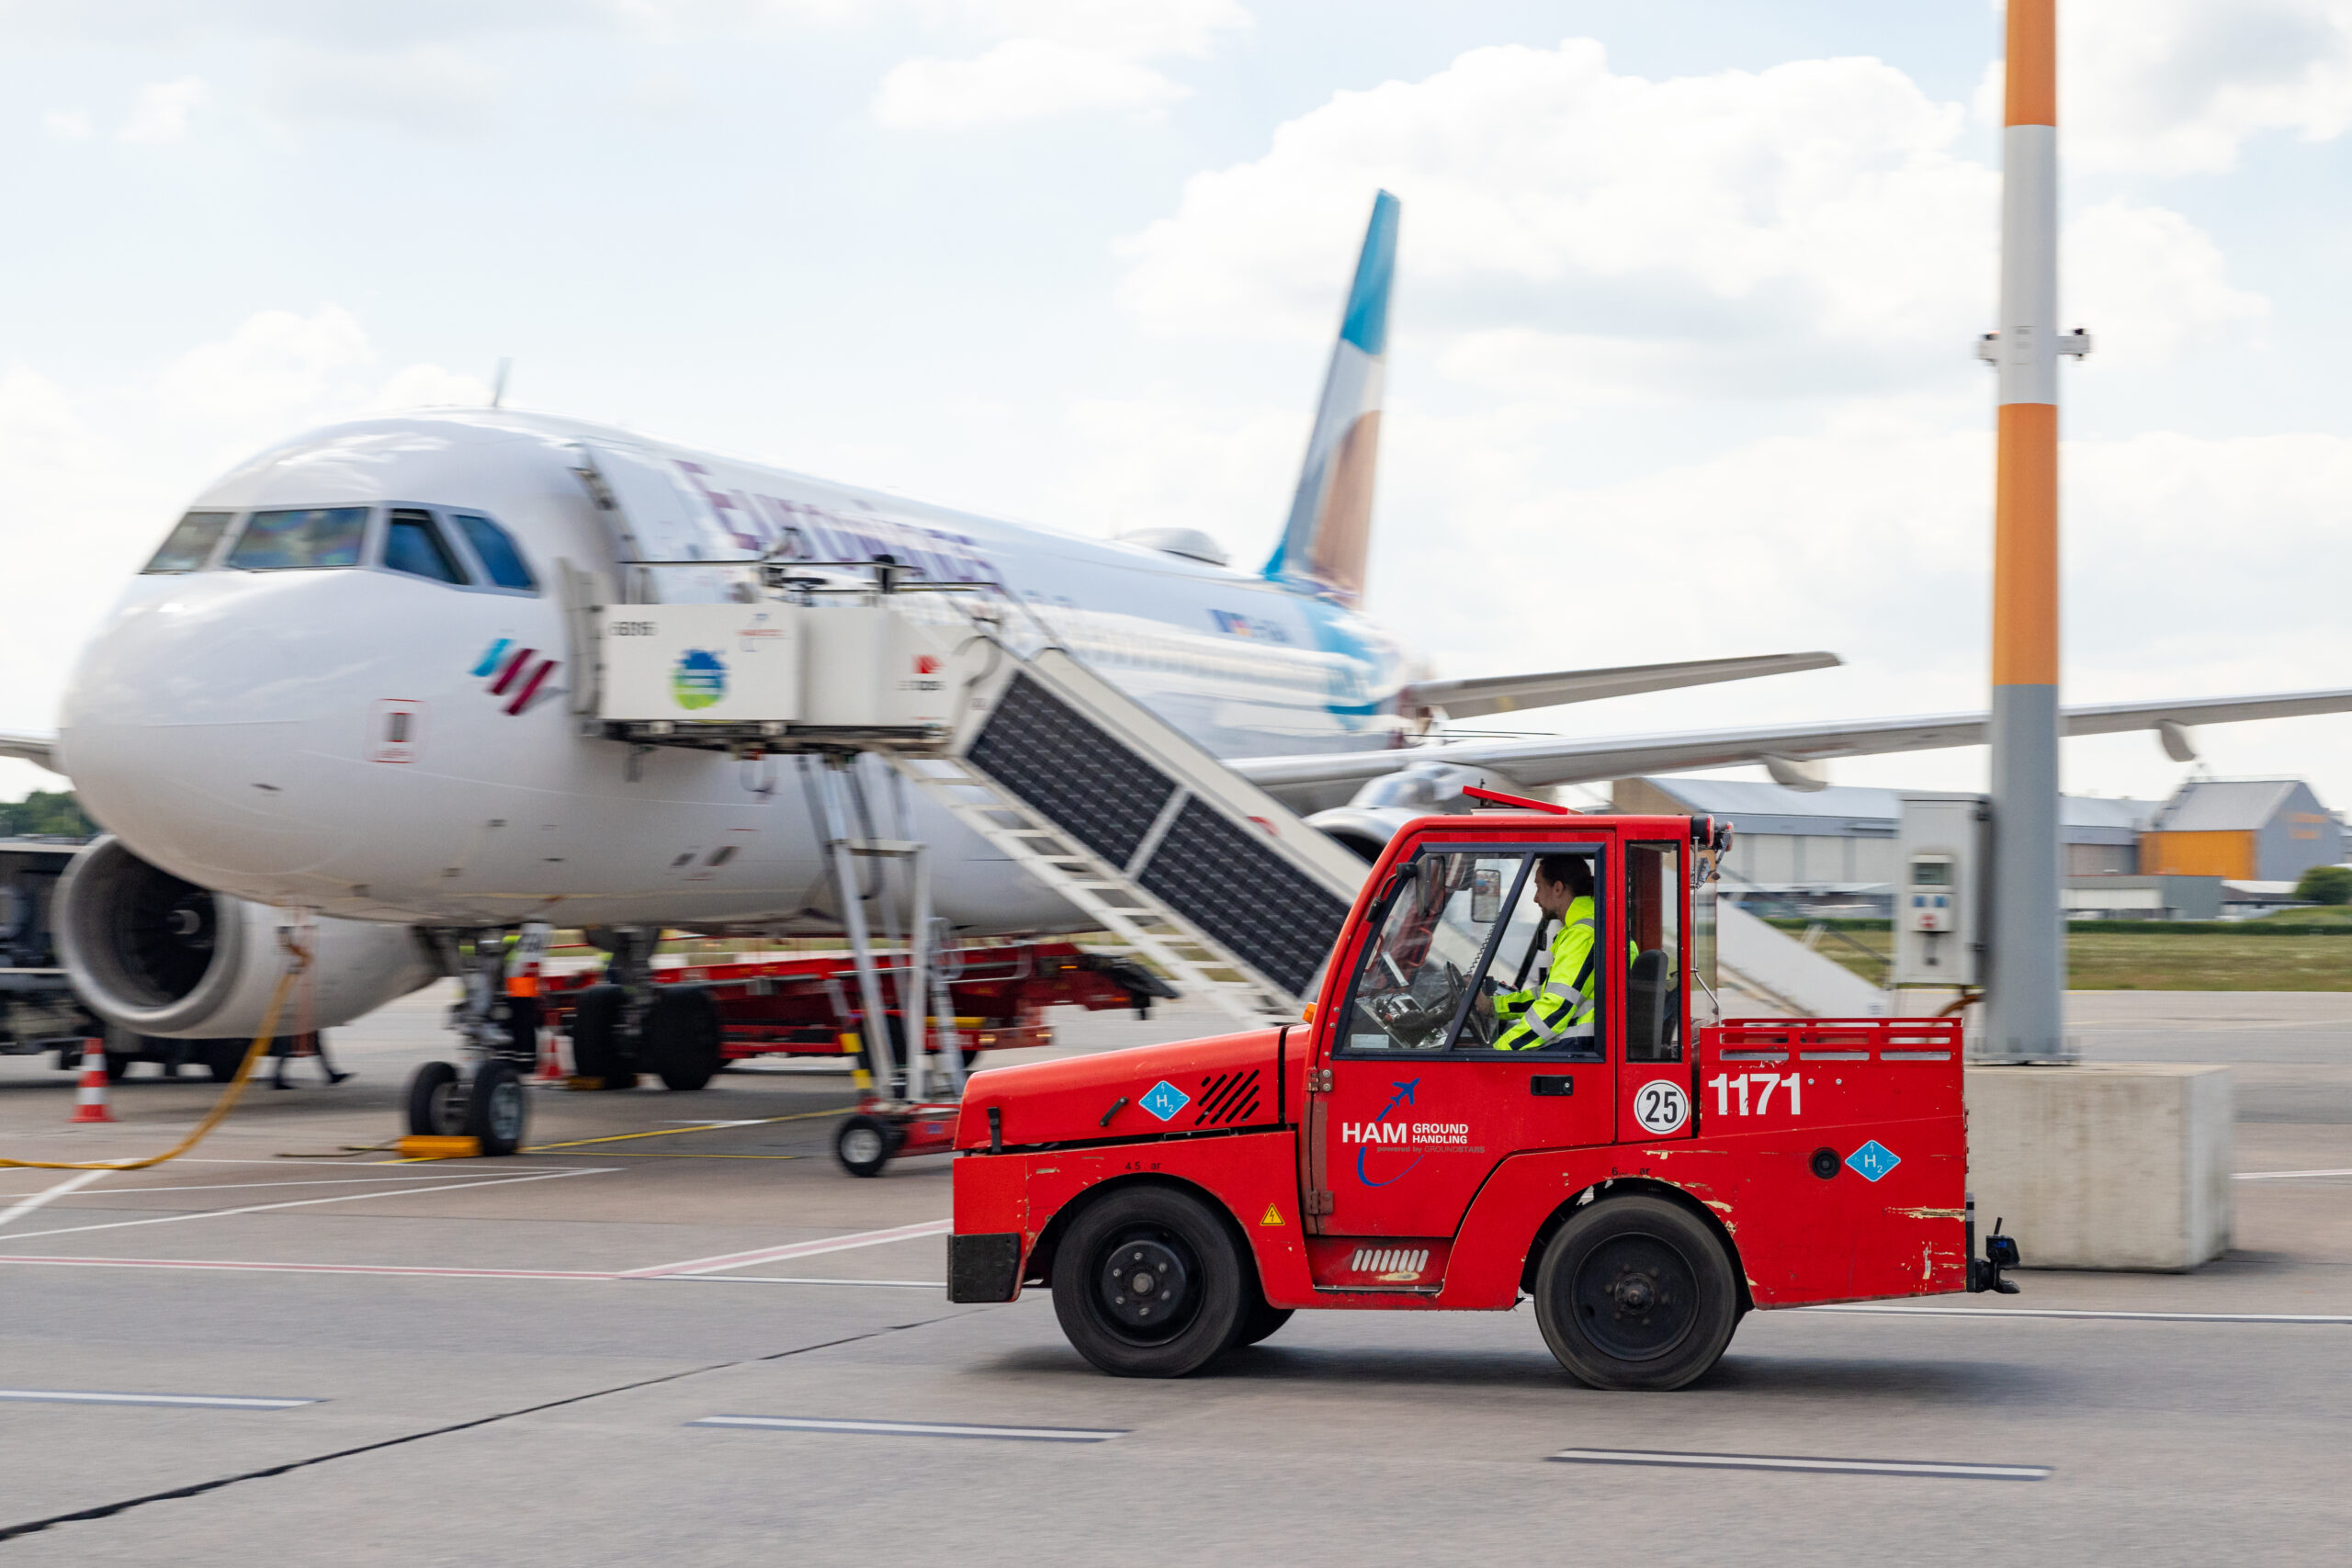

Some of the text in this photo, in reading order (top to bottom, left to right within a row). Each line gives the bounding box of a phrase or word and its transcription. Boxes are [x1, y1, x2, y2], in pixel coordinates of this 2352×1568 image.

[1708, 1073, 1801, 1116] 1171
[1645, 1090, 1678, 1123] 25
[1342, 1122, 1407, 1144] HAM
[1412, 1123, 1469, 1134] GROUND
[1412, 1135, 1467, 1145] HANDLING
[1413, 1145, 1422, 1154] by
